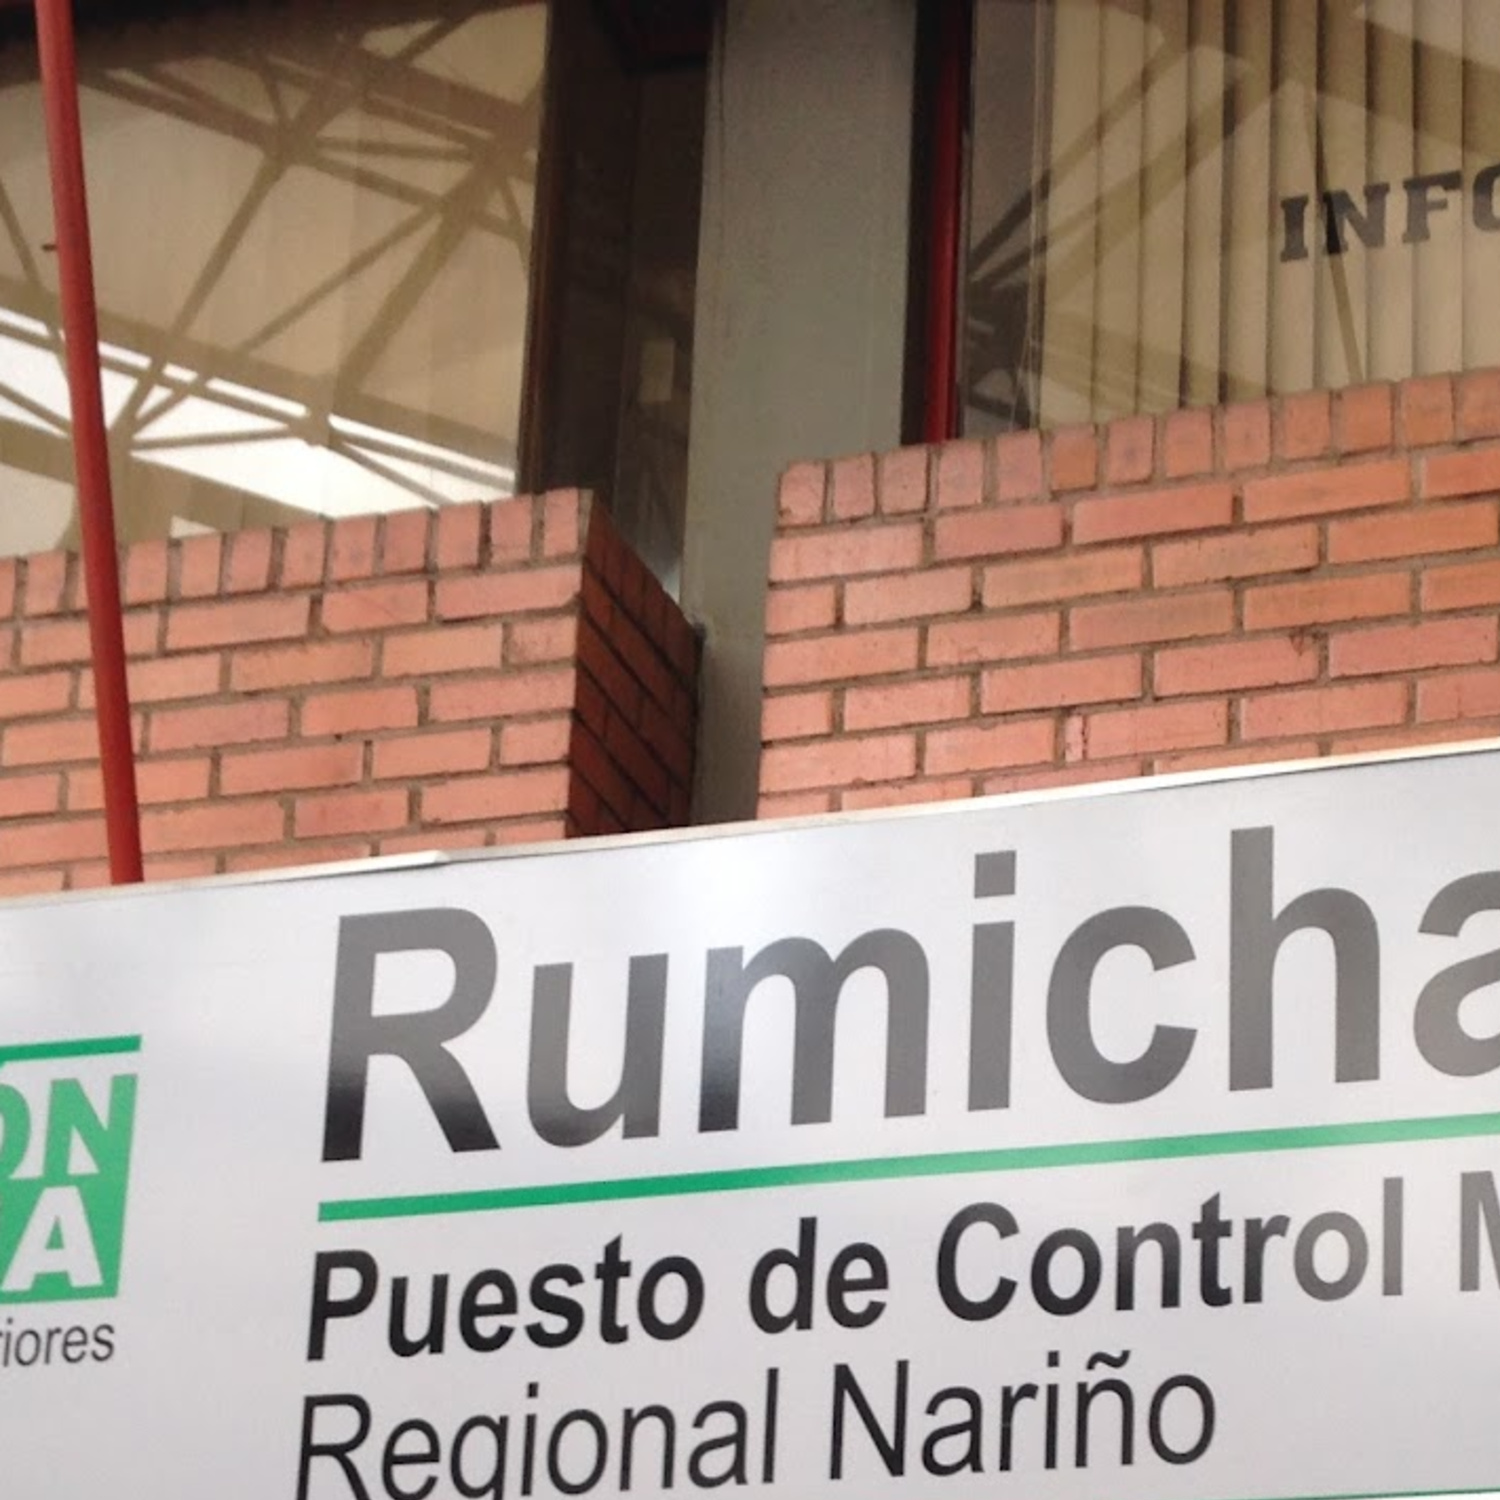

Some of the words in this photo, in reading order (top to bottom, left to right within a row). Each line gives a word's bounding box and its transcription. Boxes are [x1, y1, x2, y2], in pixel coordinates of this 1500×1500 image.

[306, 1234, 705, 1362] Puesto
[748, 1216, 890, 1335] de
[936, 1177, 1404, 1322] Control
[829, 1350, 1217, 1481] Nariño
